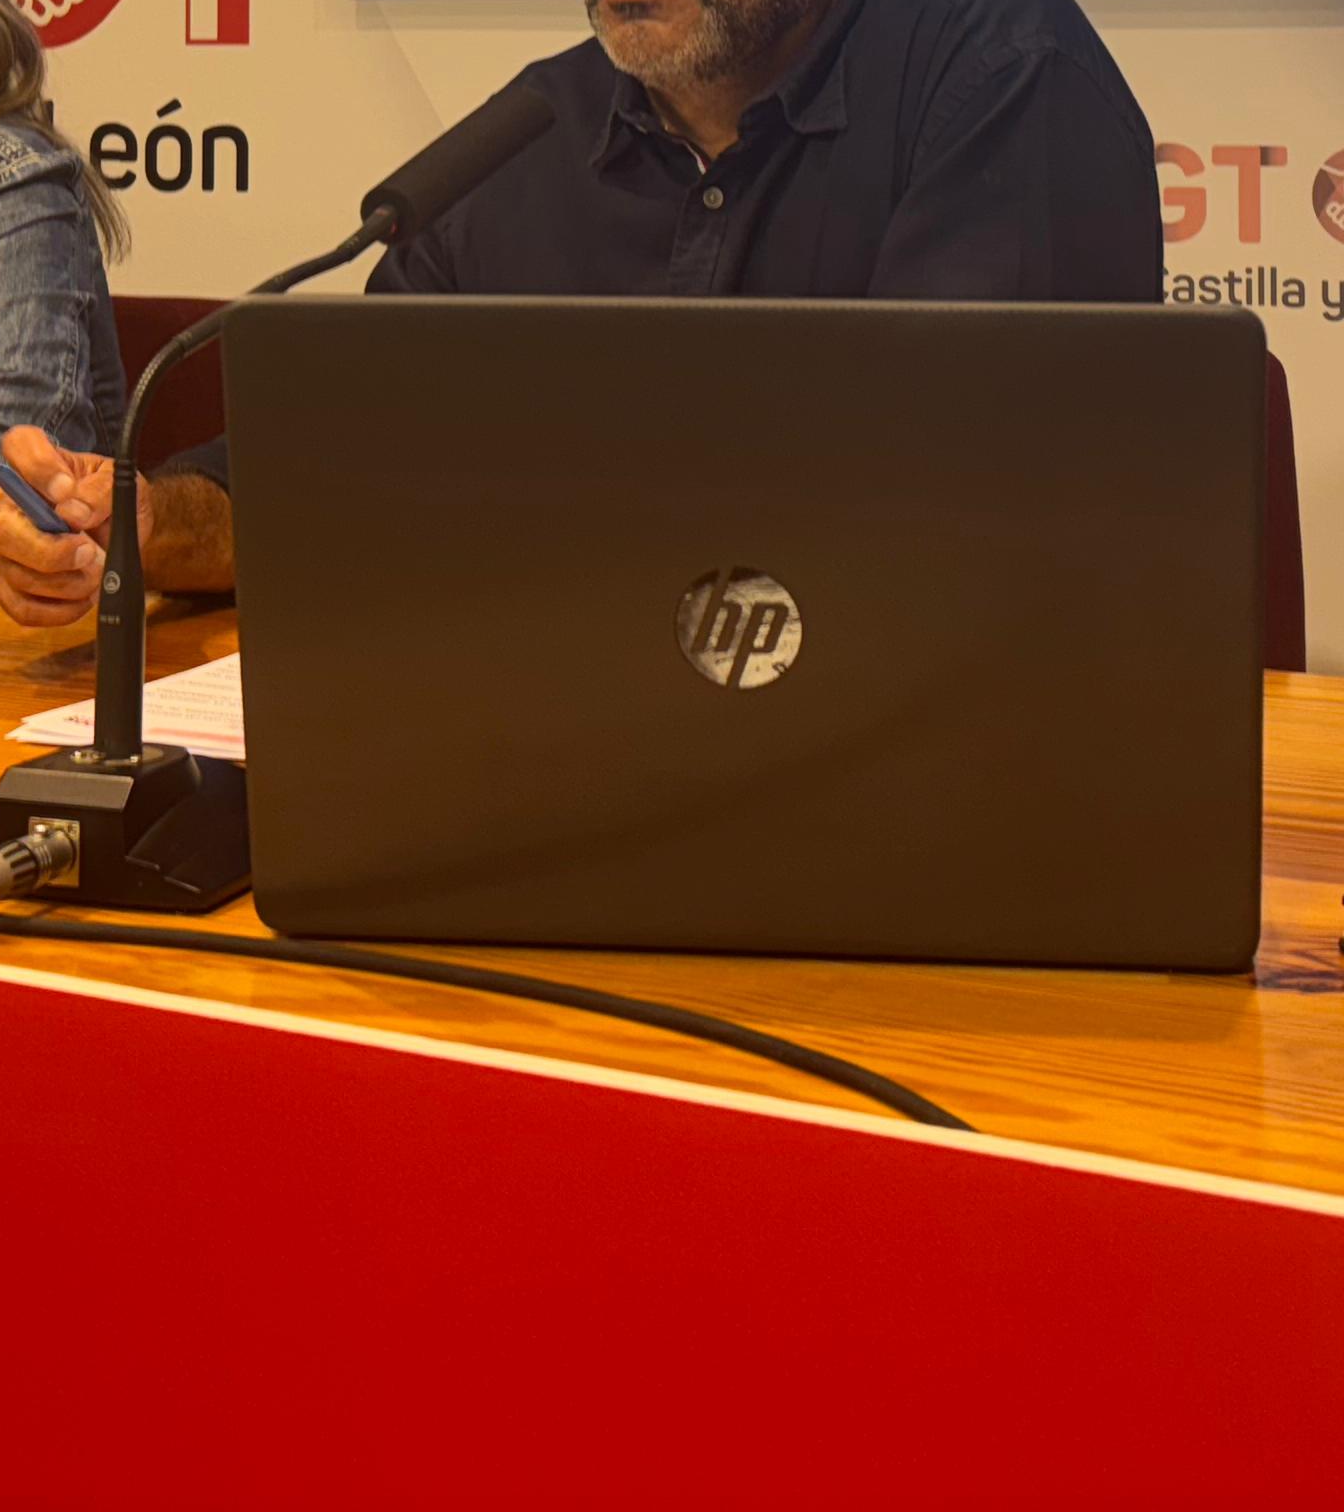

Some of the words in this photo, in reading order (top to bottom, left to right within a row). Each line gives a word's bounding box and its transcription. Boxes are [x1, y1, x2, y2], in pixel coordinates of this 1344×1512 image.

[41, 97, 249, 193] eón
[1160, 265, 1307, 309] astilla
[688, 567, 790, 688] hp
